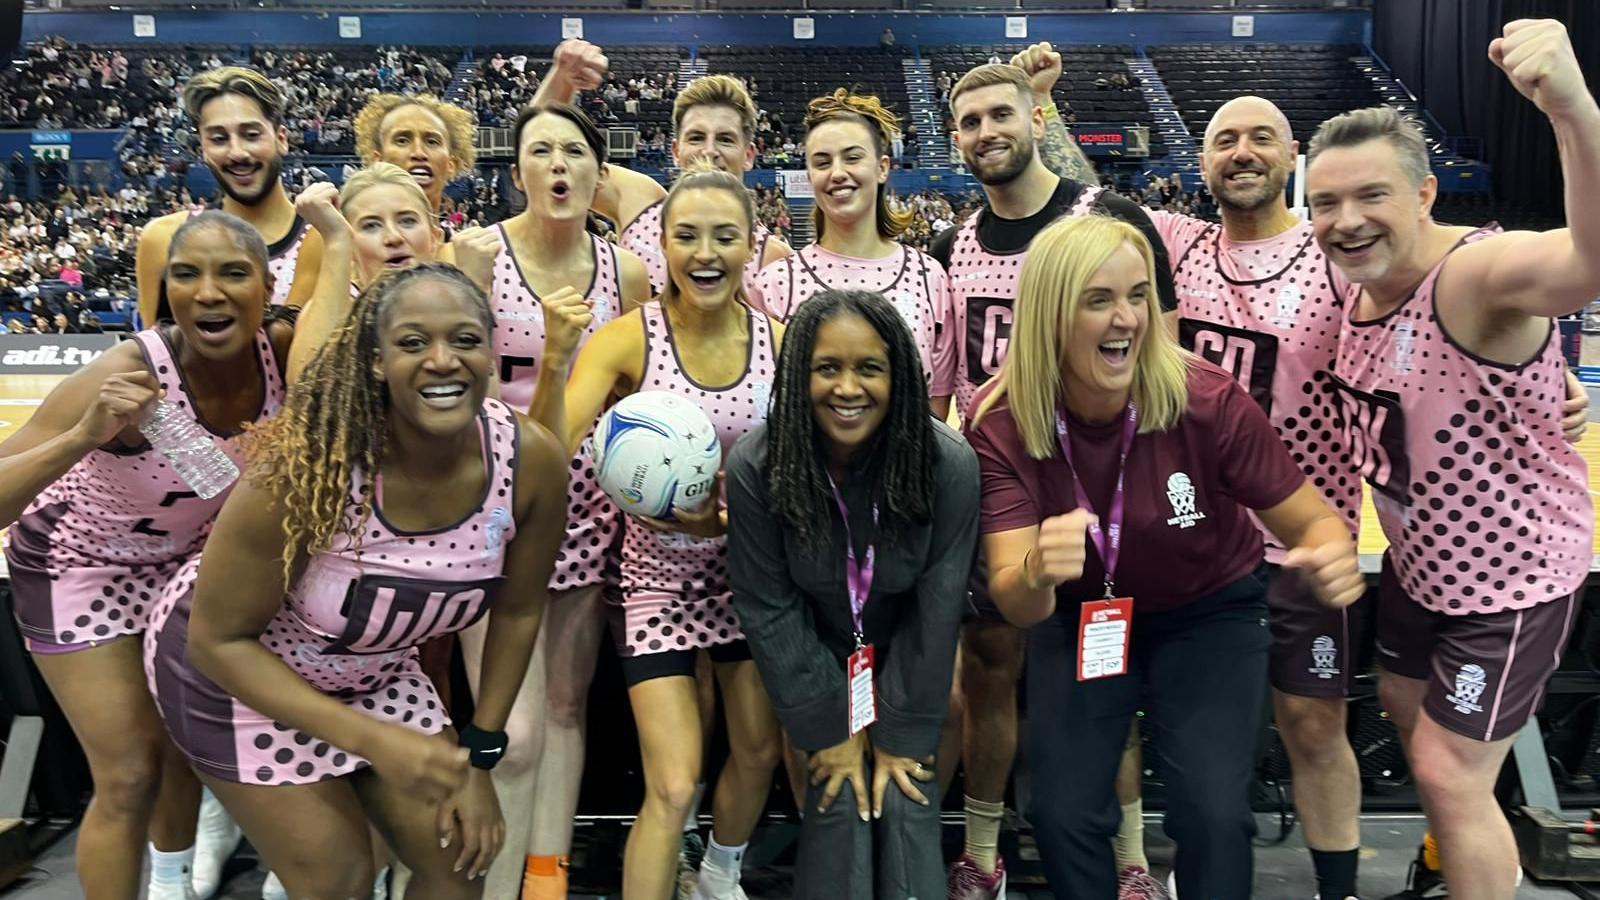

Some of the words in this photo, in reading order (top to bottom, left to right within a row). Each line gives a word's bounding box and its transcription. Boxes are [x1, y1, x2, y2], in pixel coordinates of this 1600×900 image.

[1079, 134, 1123, 143] MONSTER
[2, 345, 103, 366] adi.tv
[1167, 511, 1206, 525] NETBALL
[1180, 519, 1196, 528] AID
